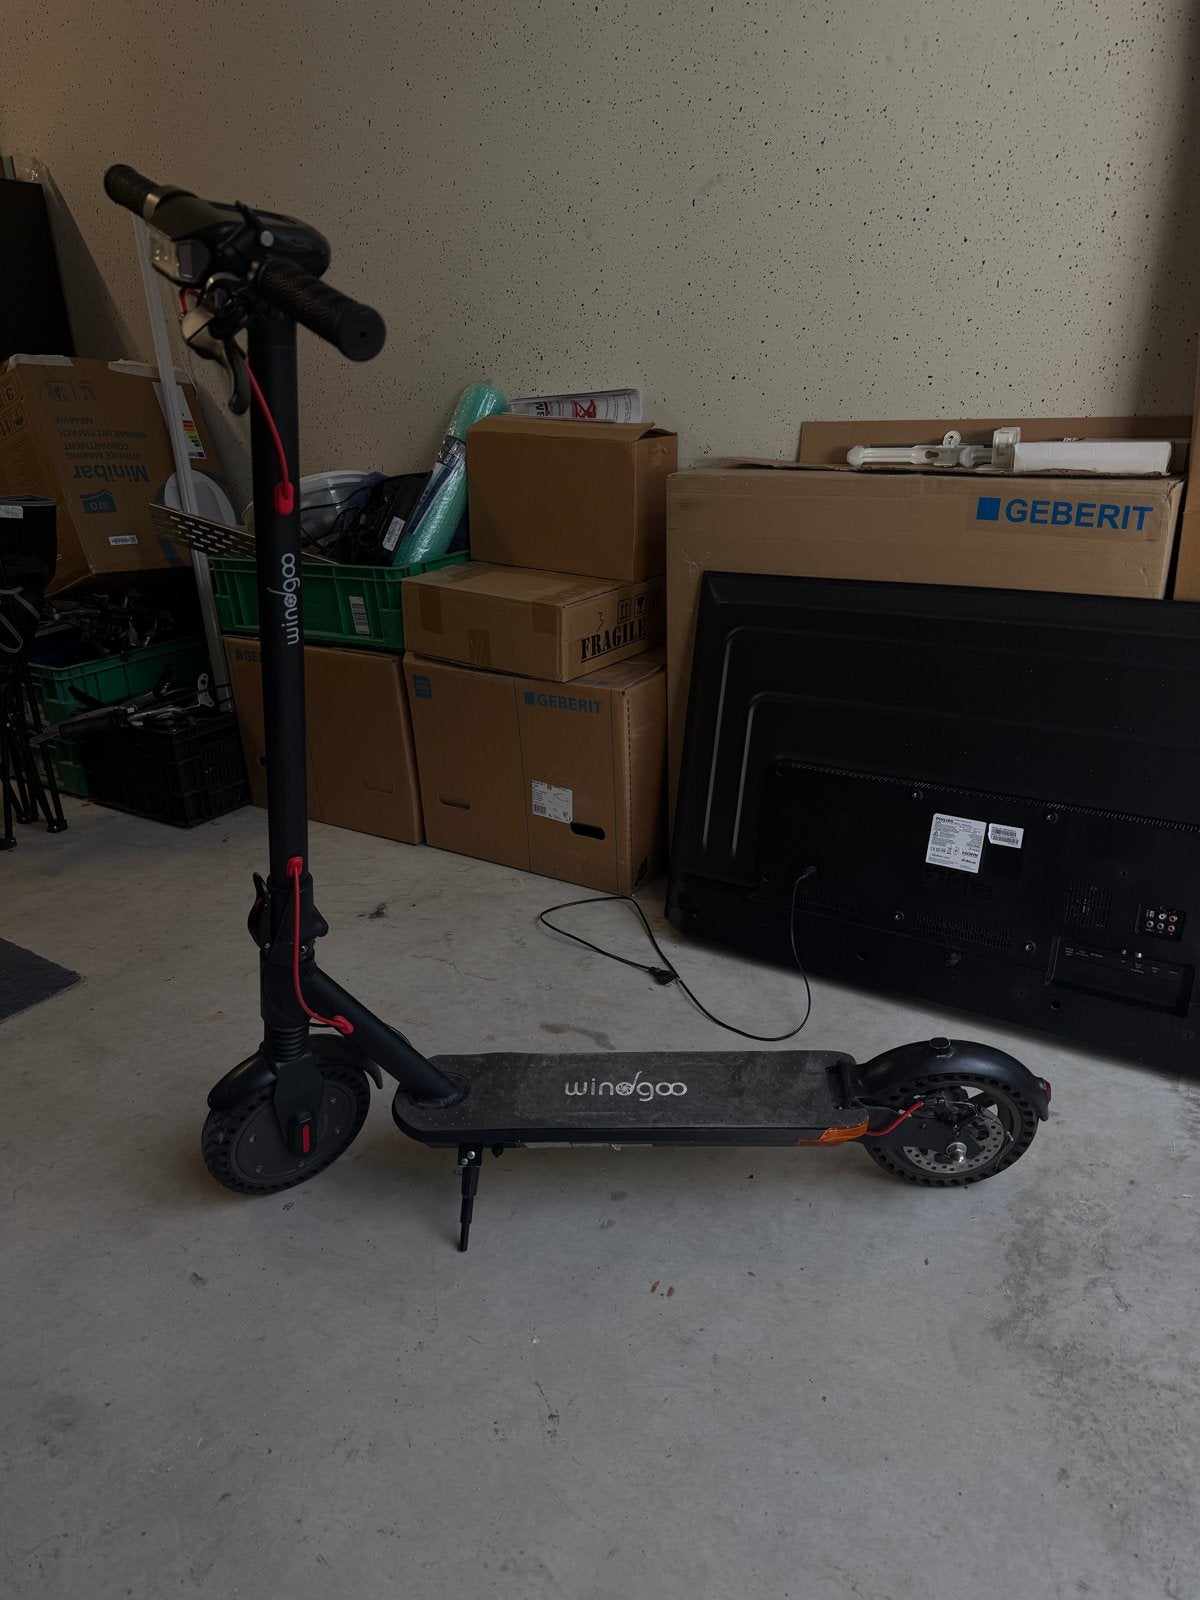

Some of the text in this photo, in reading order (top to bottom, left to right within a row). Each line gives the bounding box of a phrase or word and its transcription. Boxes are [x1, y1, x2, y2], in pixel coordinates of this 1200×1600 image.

[64, 442, 129, 451] COMPARTMENT
[65, 451, 103, 461] MAKING
[119, 451, 141, 461] WITH
[73, 465, 149, 483] Minibar
[1005, 498, 1154, 531] GEBERIT
[266, 552, 301, 646] windgoo
[580, 617, 647, 660] FRAGILE
[537, 693, 603, 715] GEBERIT
[564, 1070, 688, 1102] windgoo
